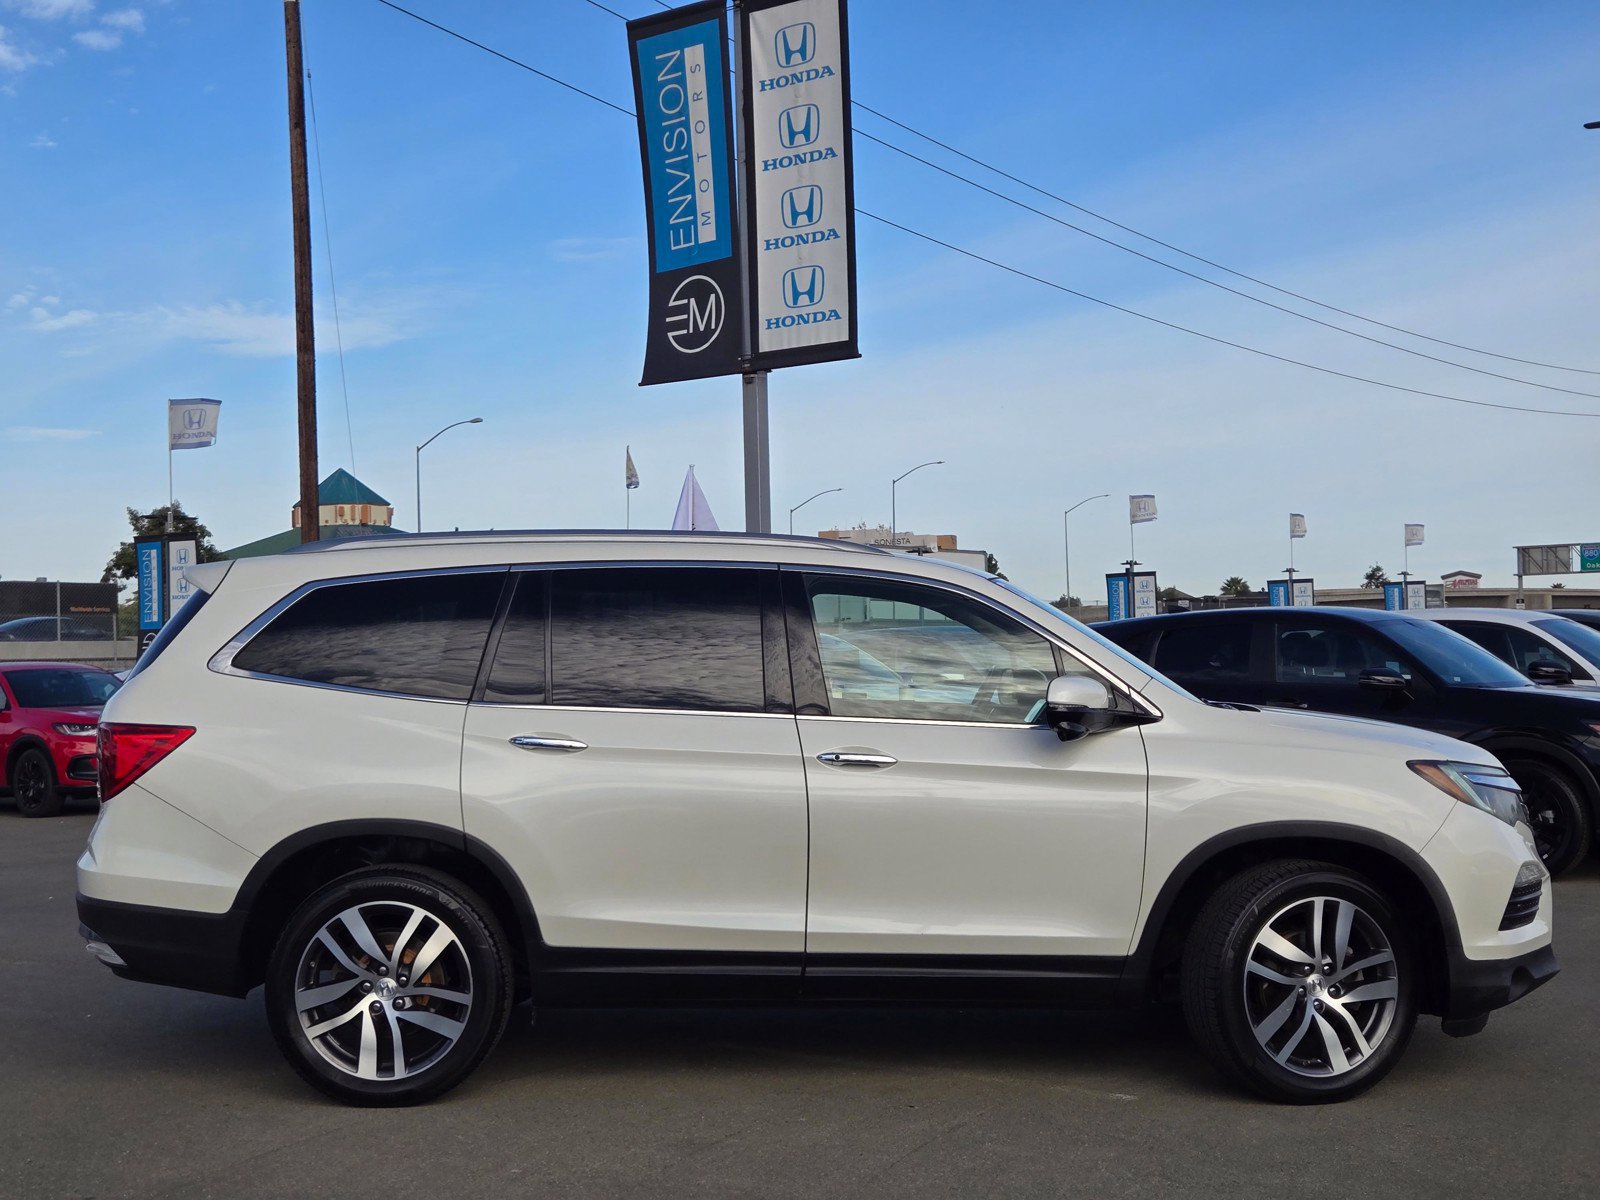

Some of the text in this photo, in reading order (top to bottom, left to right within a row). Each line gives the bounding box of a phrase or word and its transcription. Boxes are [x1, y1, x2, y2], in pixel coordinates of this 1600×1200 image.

[759, 65, 836, 92] HONDA
[655, 50, 695, 250] ENVISION
[690, 63, 712, 226] MOTORS
[762, 147, 838, 172] HONDA
[764, 228, 841, 251] HONDA
[765, 309, 842, 330] HONDA
[173, 431, 215, 440] HONDA
[142, 549, 153, 623] ENVISION
